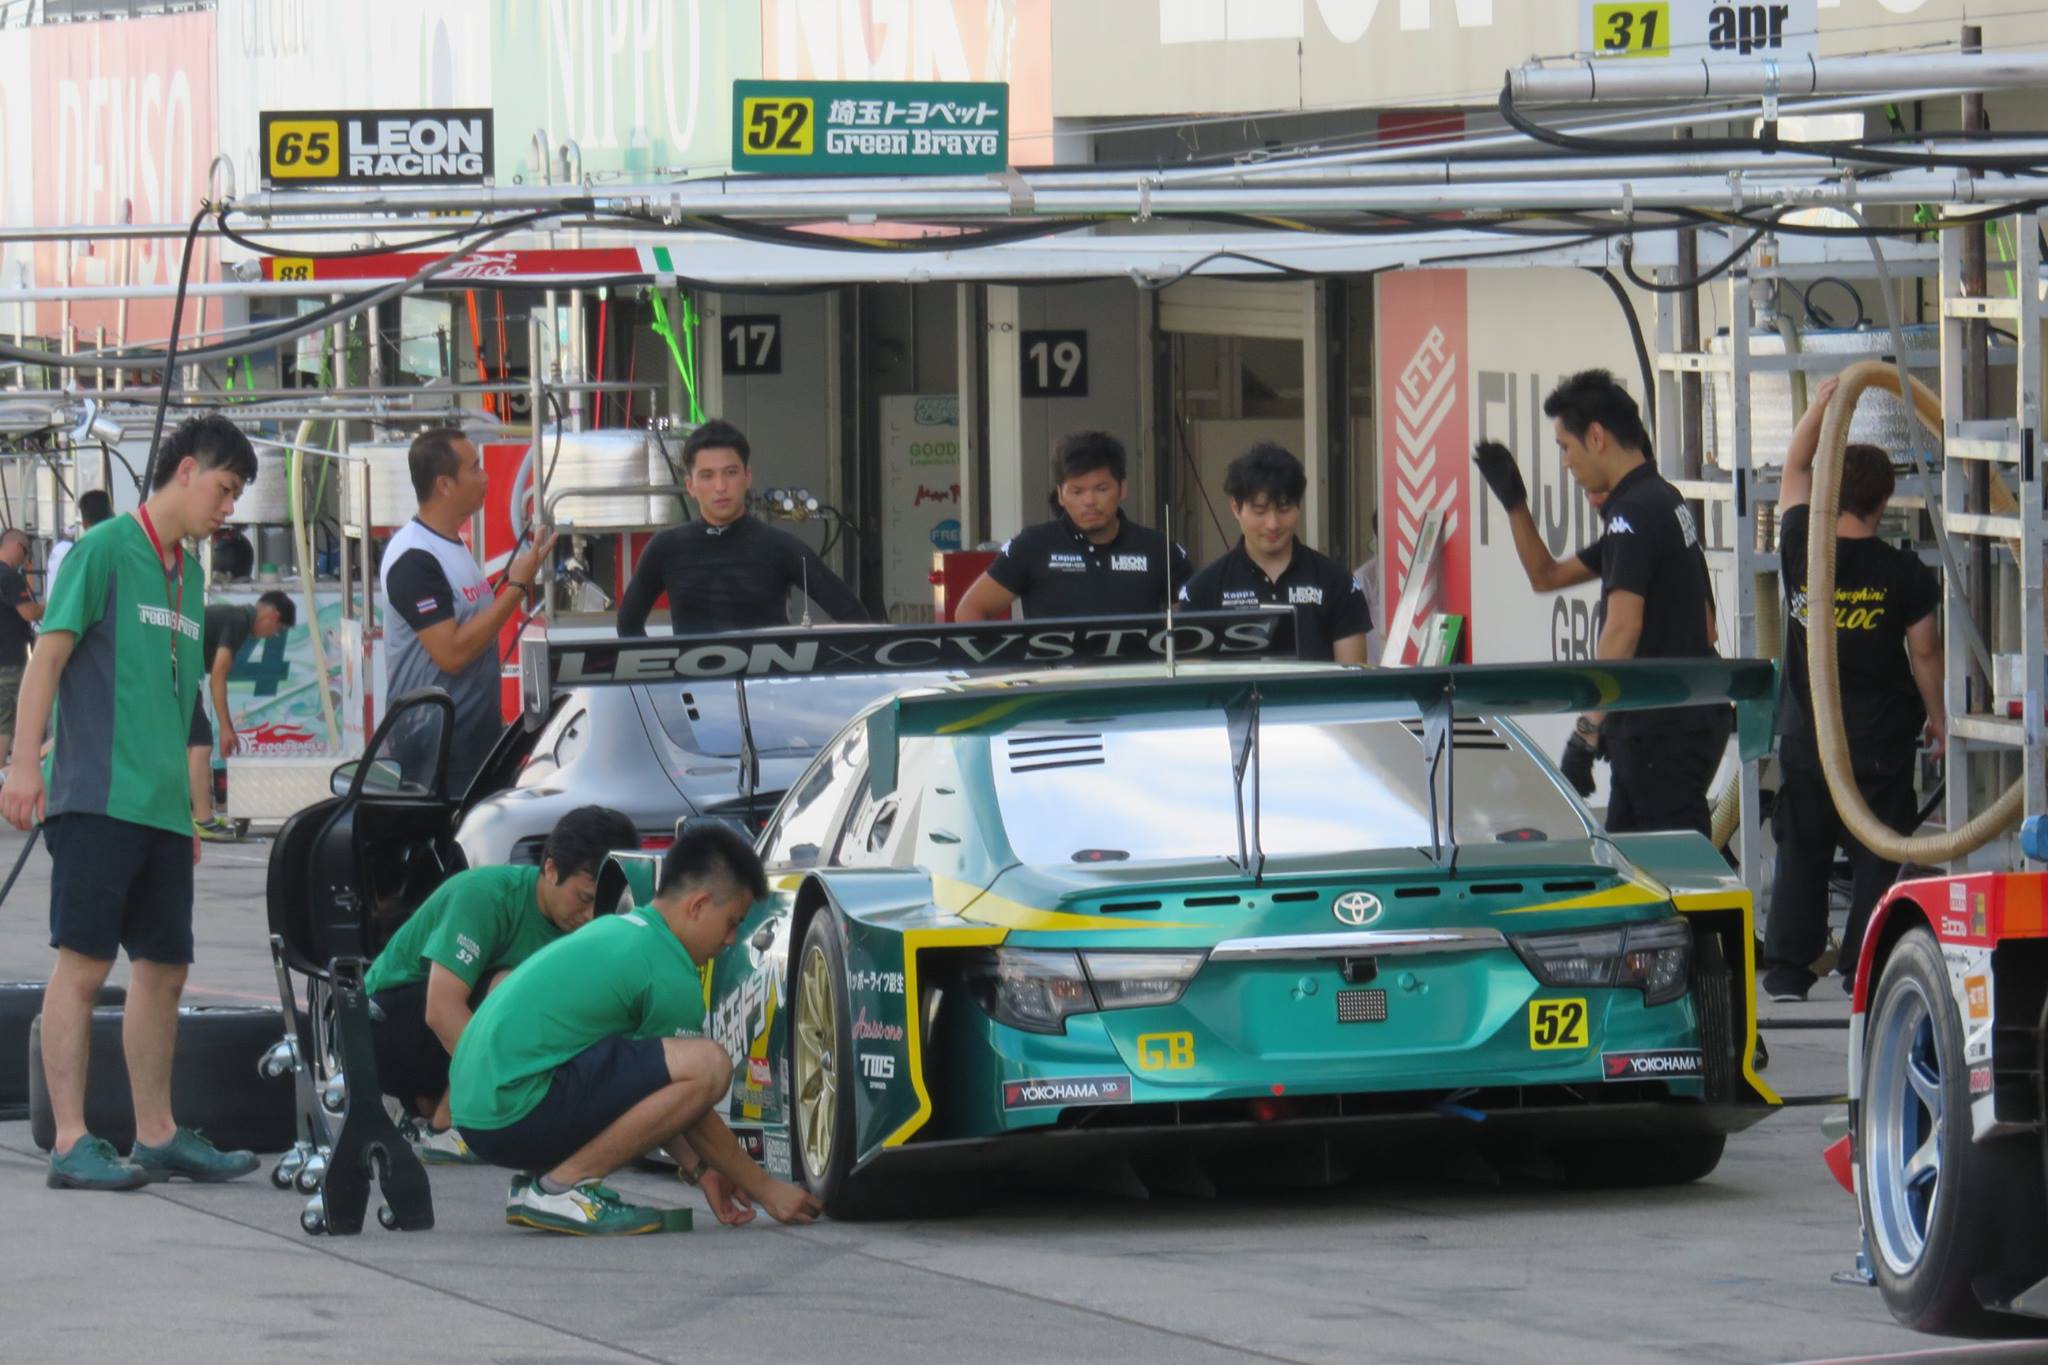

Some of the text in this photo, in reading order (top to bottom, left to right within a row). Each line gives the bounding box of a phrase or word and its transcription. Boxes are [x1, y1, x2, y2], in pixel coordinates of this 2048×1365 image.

[1604, 0, 1790, 55] 31 apr
[748, 102, 809, 150] 52
[826, 99, 999, 126] 埼玉トヨペット
[275, 119, 483, 167] 65 LEON
[826, 129, 999, 156] Green Brave
[58, 68, 193, 288] DENSO
[349, 153, 483, 176] RACING
[279, 264, 309, 281] 88
[728, 324, 776, 366] 17
[1028, 341, 1082, 388] 19
[556, 641, 819, 684] LEON
[873, 622, 1273, 668] CVSTOS
[1534, 1003, 1583, 1046] 52
[860, 1053, 896, 1078] TWS
[1136, 1030, 1196, 1071] GB
[1631, 1056, 1697, 1073] YOKOHAMA
[1021, 1084, 1099, 1101] YOKOHAMA
